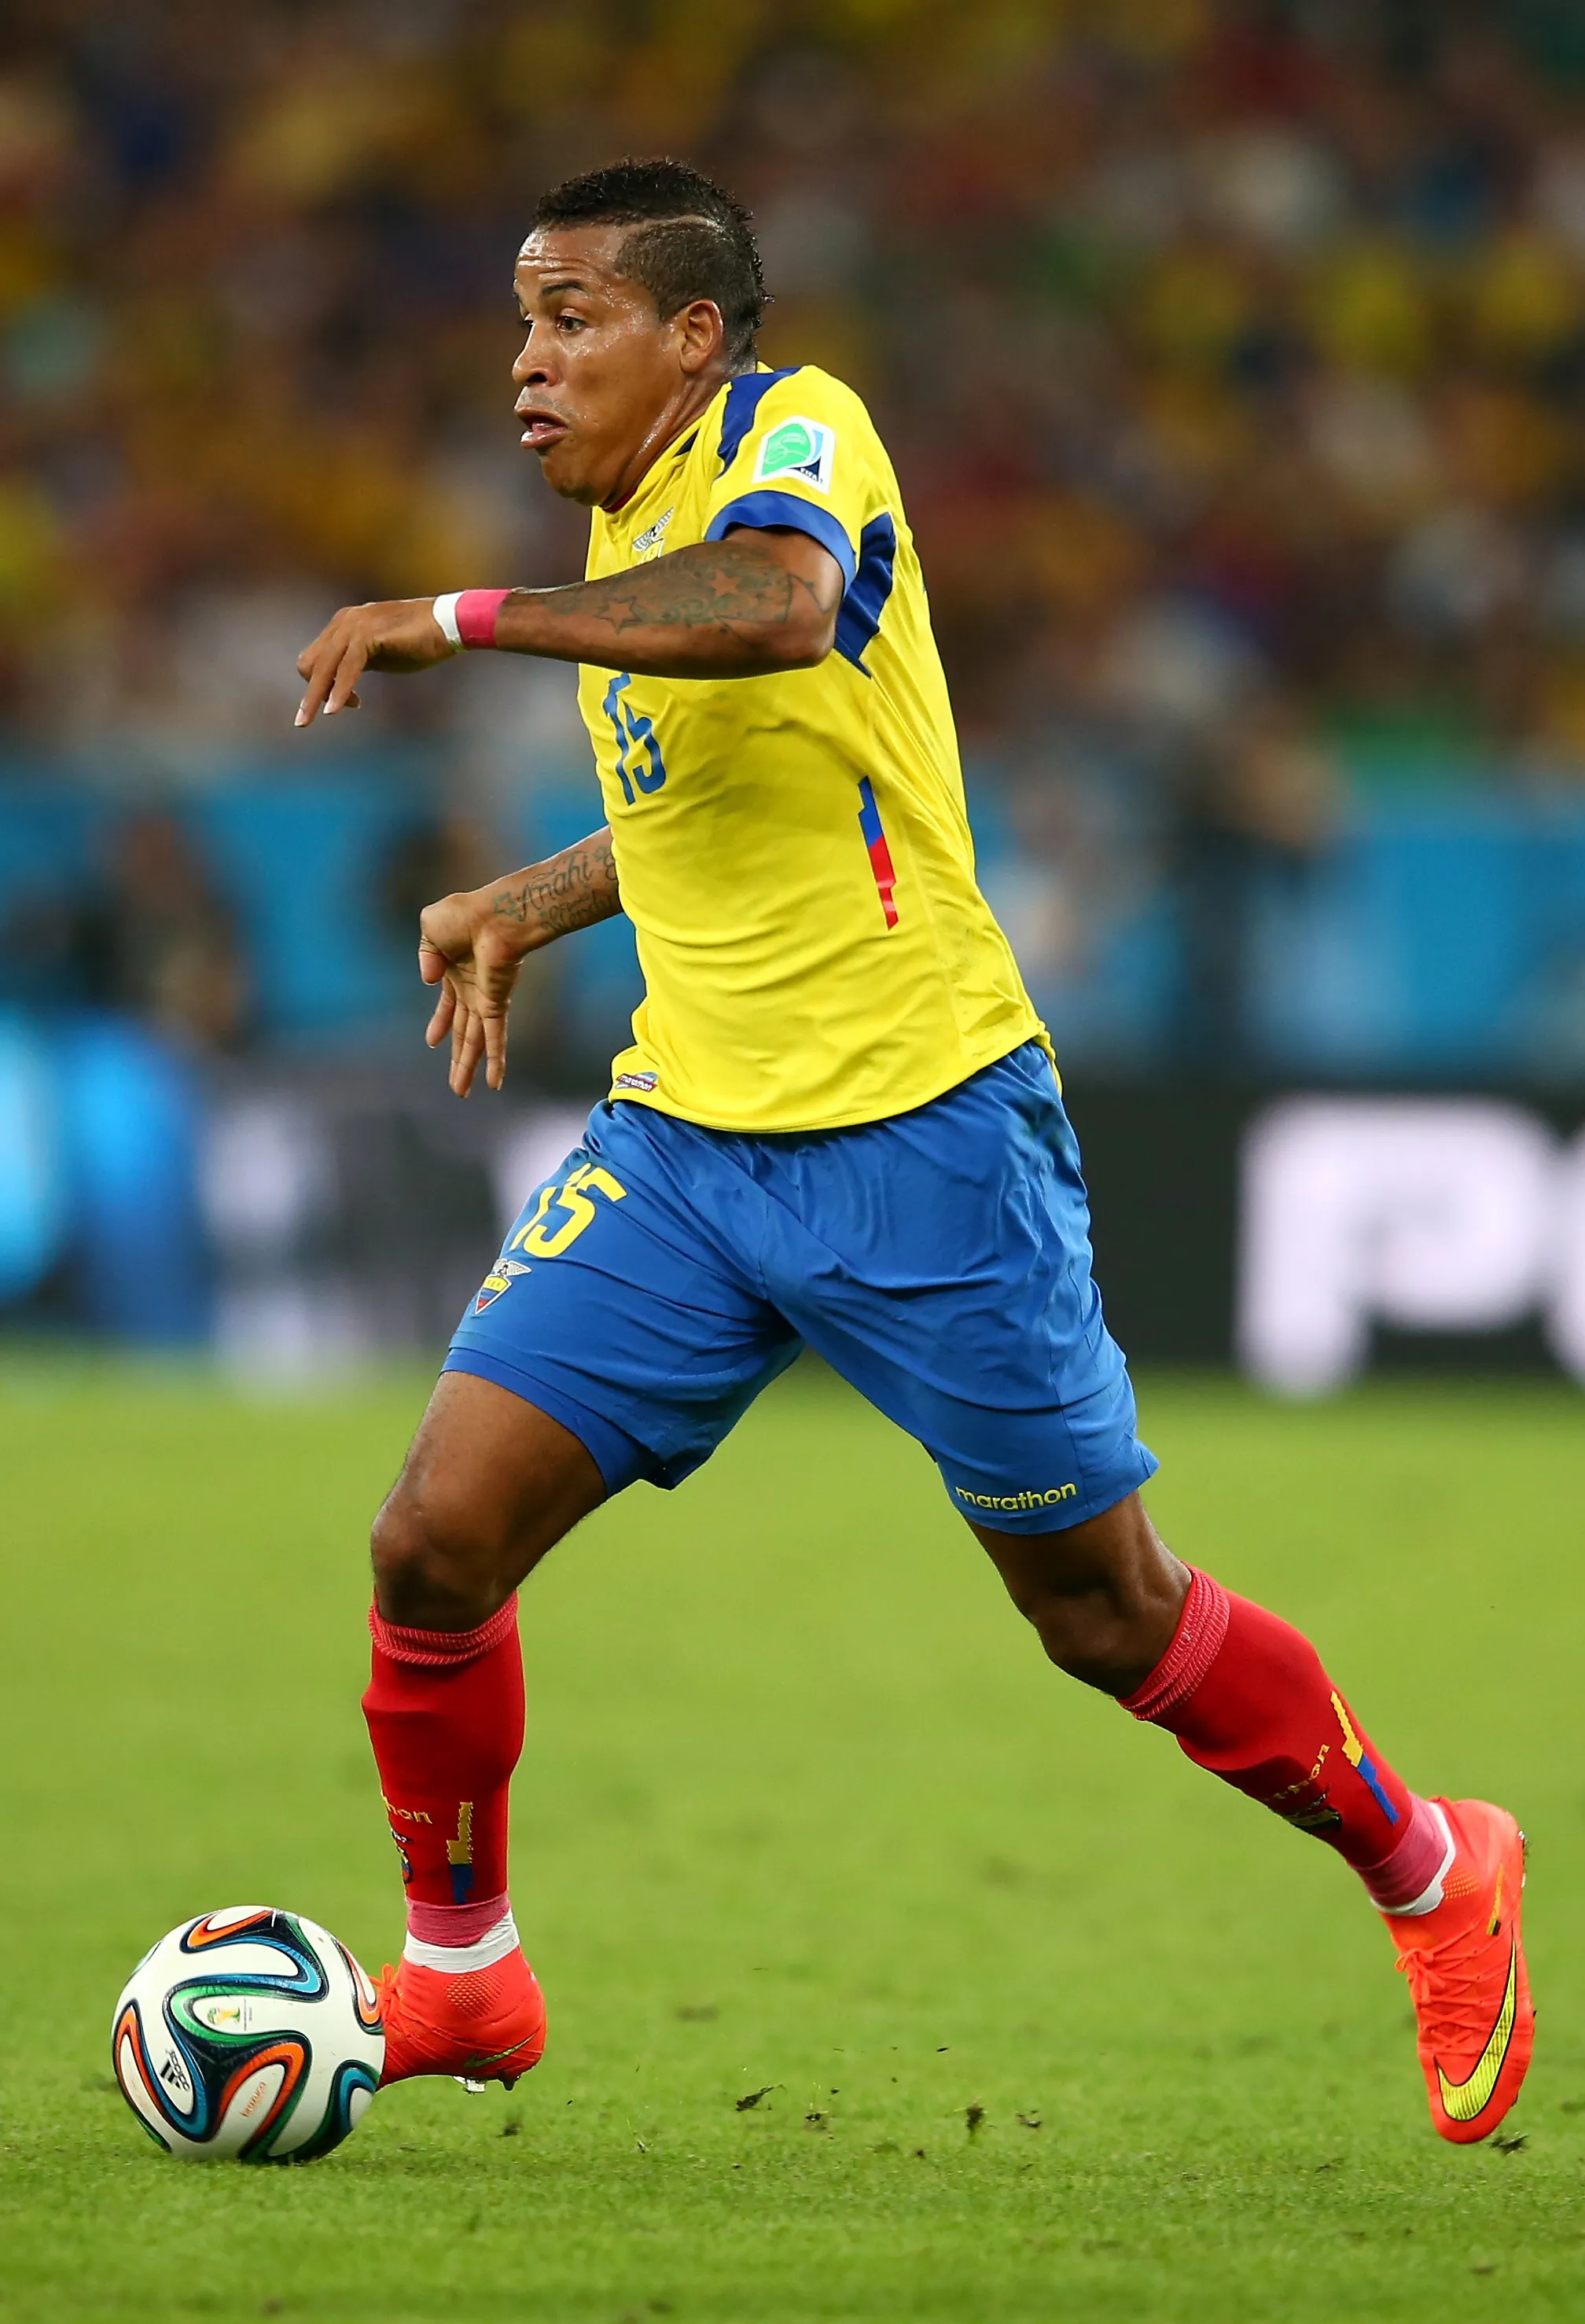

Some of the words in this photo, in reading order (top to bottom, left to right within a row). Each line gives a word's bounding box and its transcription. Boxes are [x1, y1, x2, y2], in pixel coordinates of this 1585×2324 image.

[602, 672, 667, 806] 15
[509, 1162, 627, 1258] 15
[954, 1482, 1077, 1511] marathon
